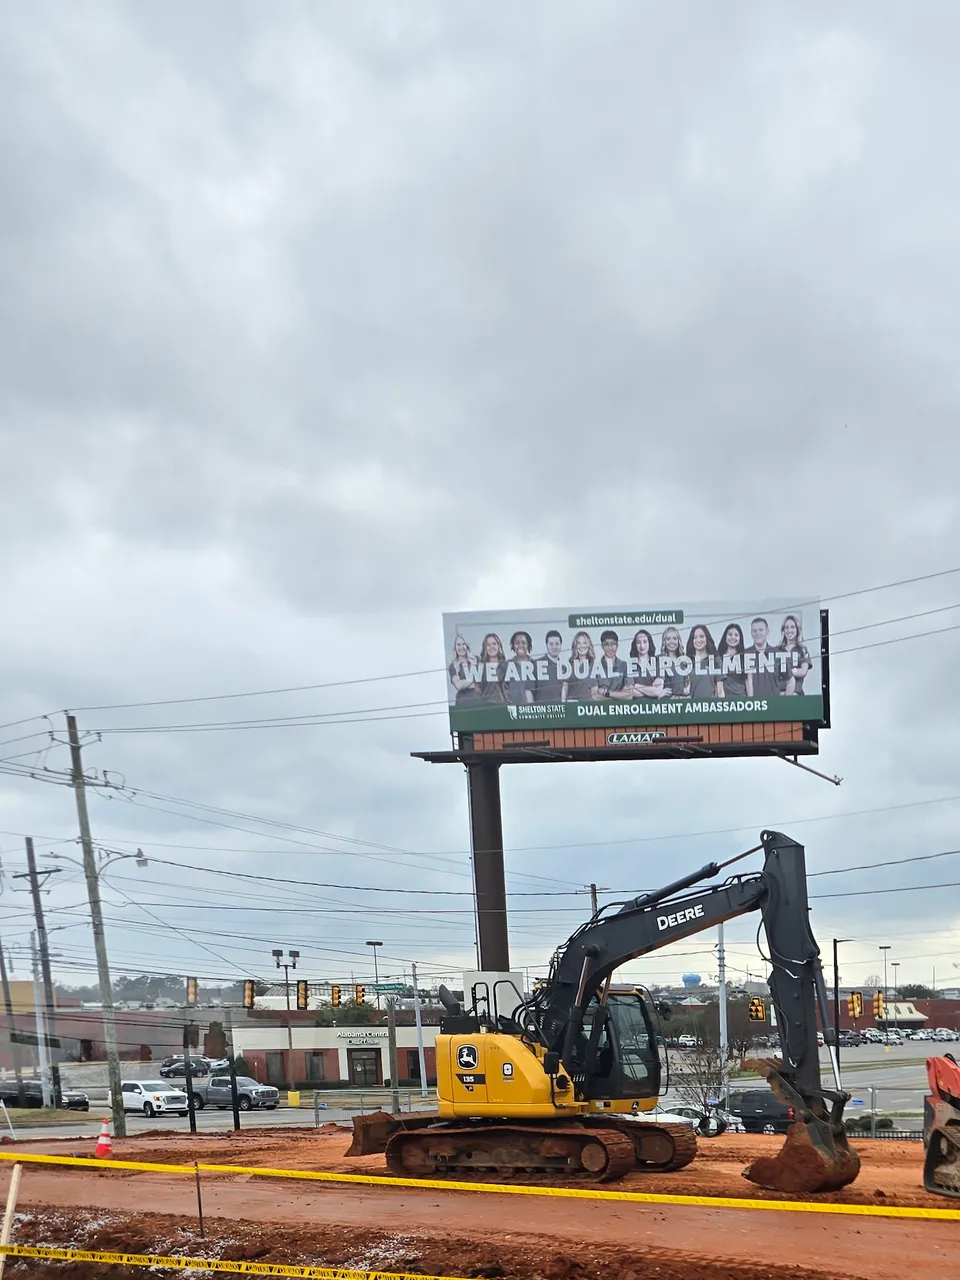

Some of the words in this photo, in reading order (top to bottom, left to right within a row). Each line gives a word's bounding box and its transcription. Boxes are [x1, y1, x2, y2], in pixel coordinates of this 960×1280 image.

[576, 613, 676, 626] sheltonstate.edu/dual
[463, 662, 499, 682] WE
[505, 660, 549, 682] ARE
[557, 657, 623, 680] DUAL
[627, 651, 799, 678] ENROLLMENT!
[518, 705, 546, 714] SHELTON
[547, 704, 566, 713] STATE
[577, 704, 606, 716] DUAL
[609, 702, 682, 716] ENROLLMENT
[685, 700, 768, 714] AMBASSADORS
[656, 904, 705, 931] DEERE
